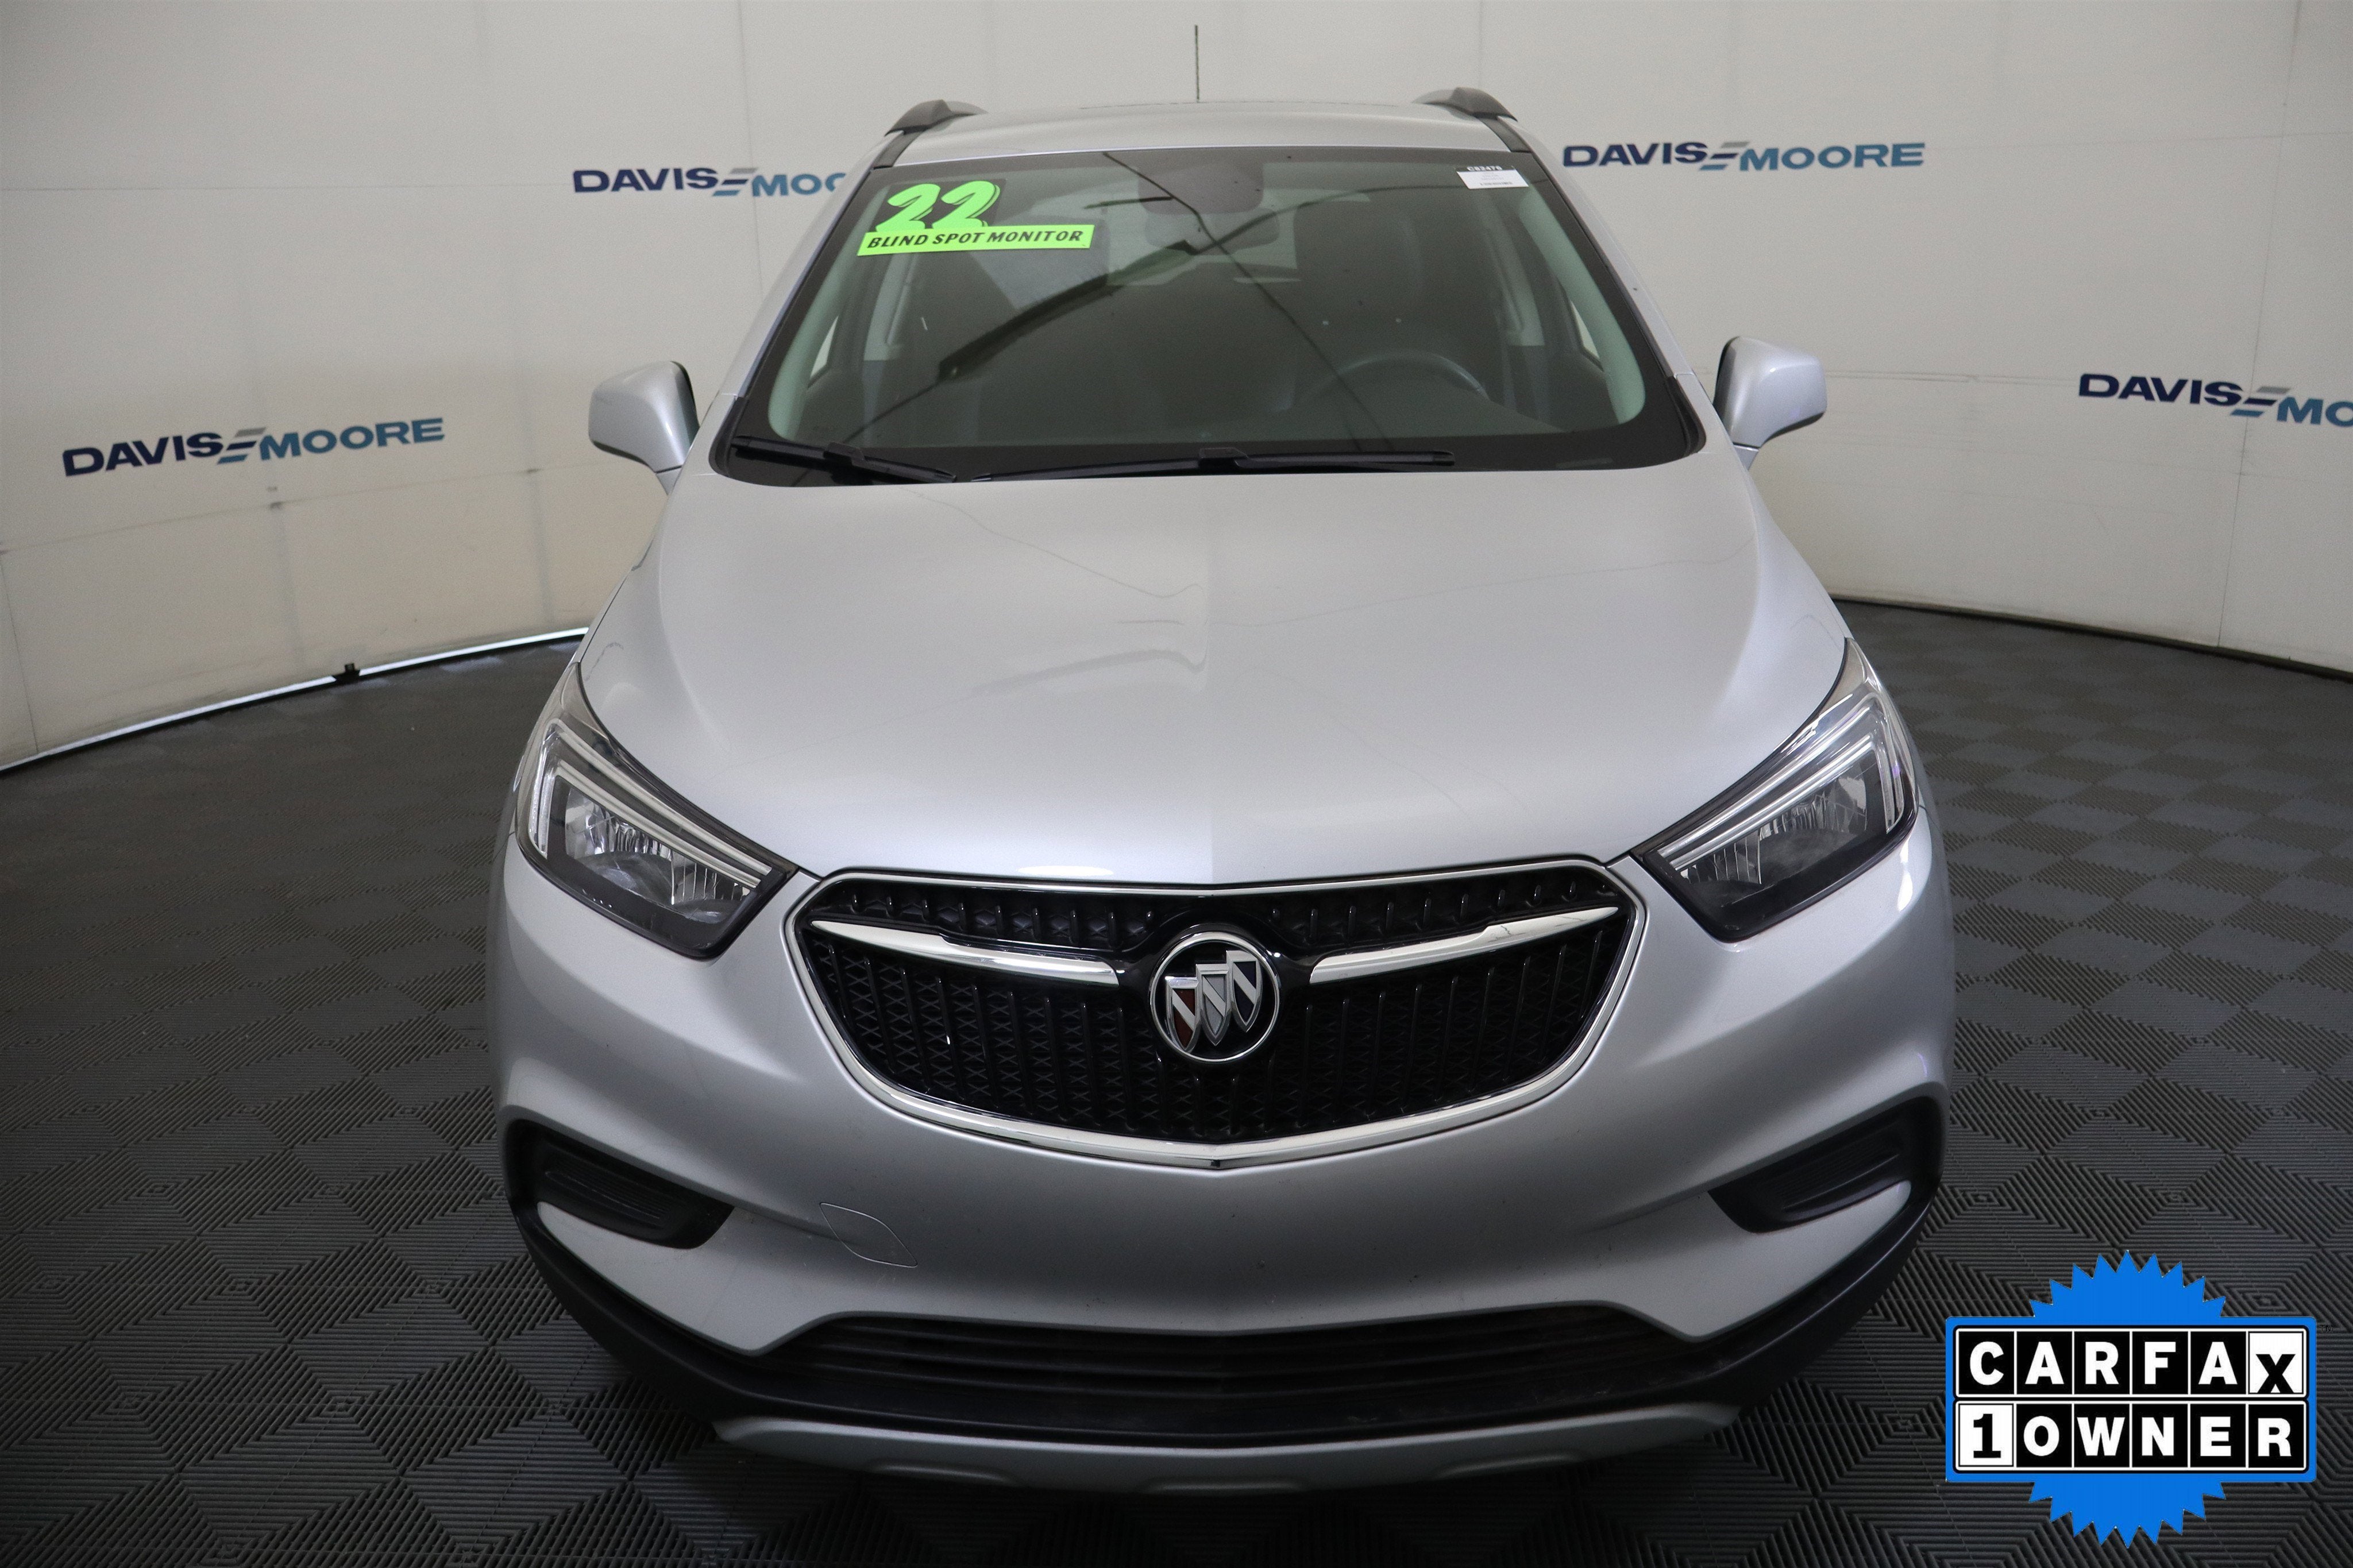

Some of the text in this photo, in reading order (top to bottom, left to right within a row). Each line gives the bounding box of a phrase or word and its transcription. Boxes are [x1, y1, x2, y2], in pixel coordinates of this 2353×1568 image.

[1563, 142, 1926, 171] DAVIS MOORE
[573, 167, 718, 193] DAVIS
[875, 180, 1000, 232] 22
[867, 230, 1084, 248] BLIND SPOT MONITOR
[2078, 373, 2243, 407] DAVIS
[62, 418, 445, 476] DAVIS MOORE
